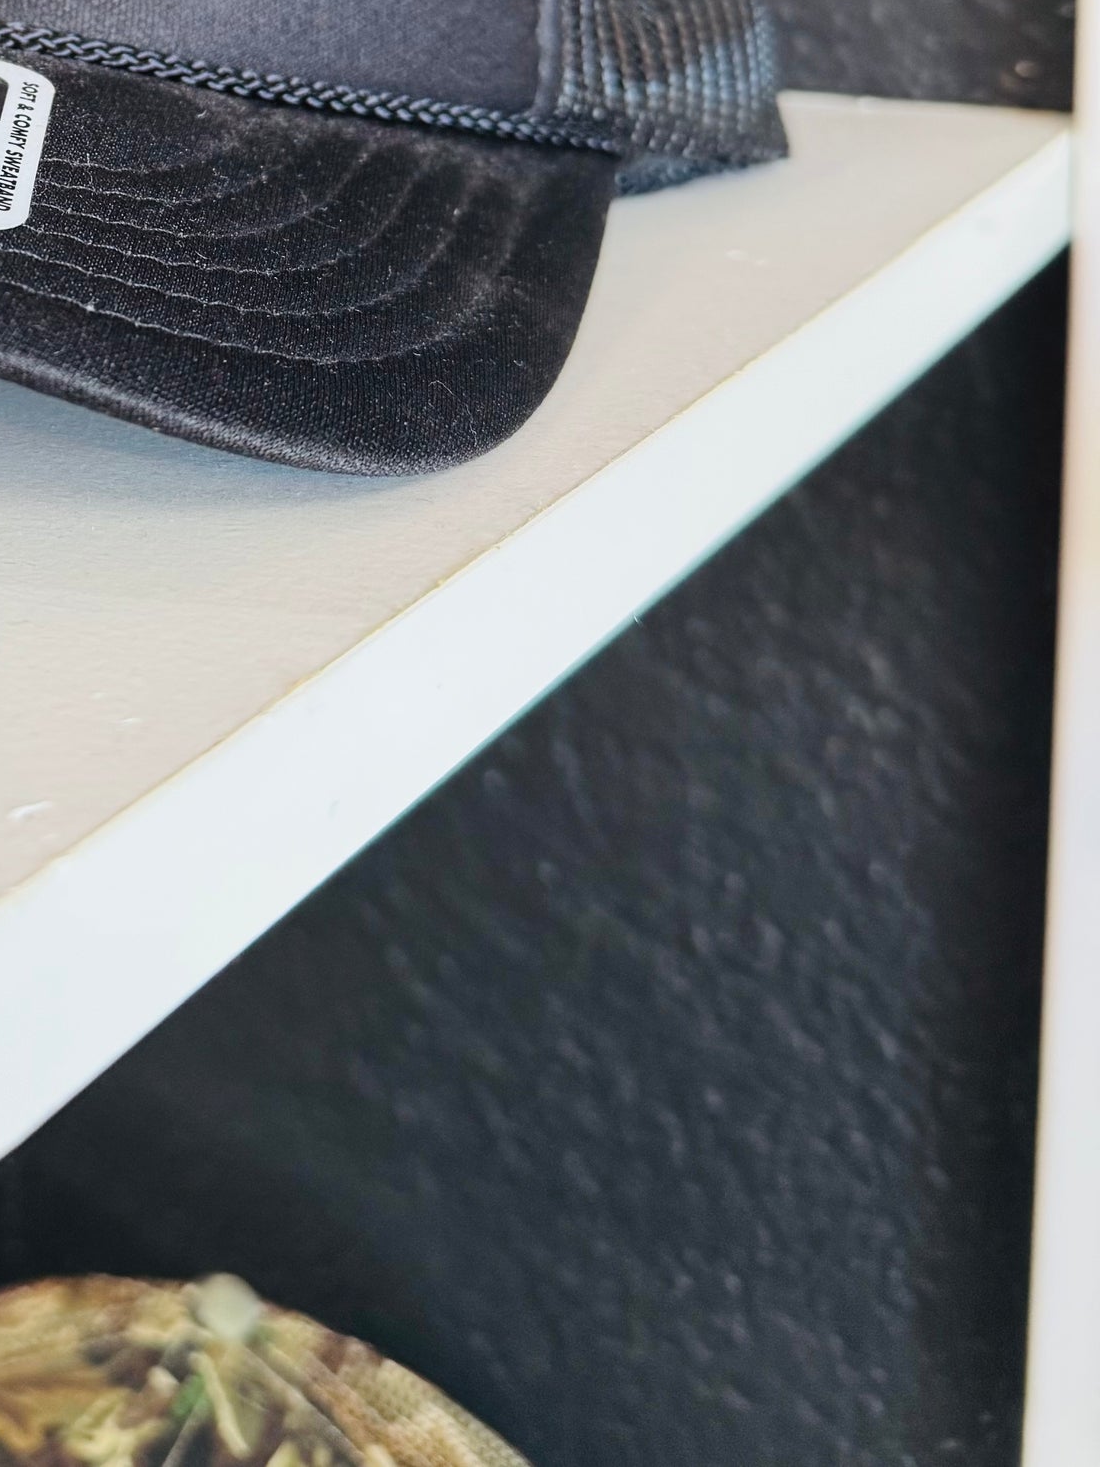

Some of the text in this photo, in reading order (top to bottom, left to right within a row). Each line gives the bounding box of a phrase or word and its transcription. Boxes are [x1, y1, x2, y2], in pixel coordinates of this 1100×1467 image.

[19, 81, 39, 103] SOFT
[16, 103, 35, 111] &
[8, 114, 32, 150] COMFY
